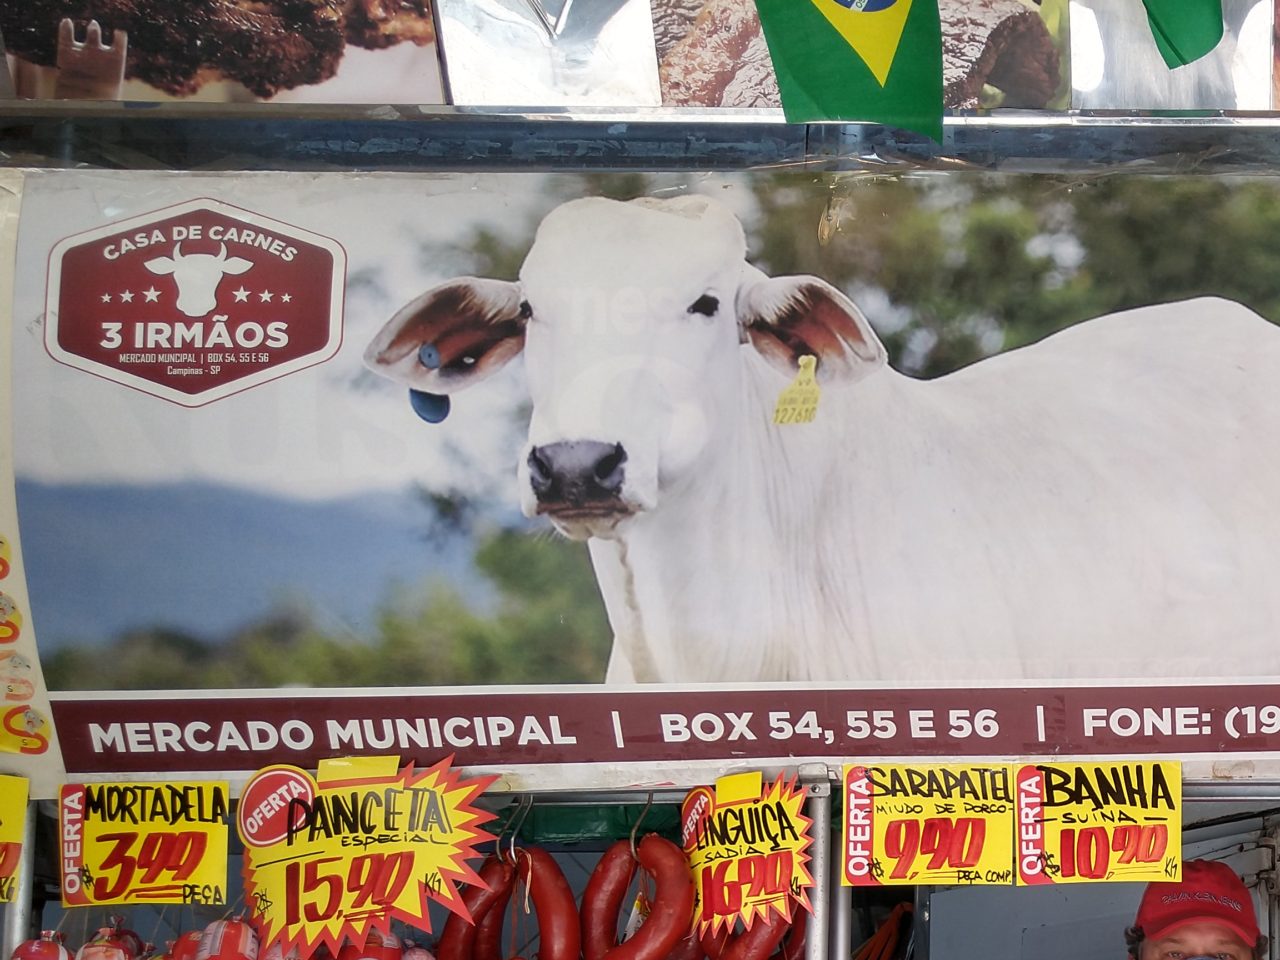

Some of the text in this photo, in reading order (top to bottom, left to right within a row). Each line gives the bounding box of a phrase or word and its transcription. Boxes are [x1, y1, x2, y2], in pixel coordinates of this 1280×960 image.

[103, 225, 298, 262] CASA DE CARNES
[100, 314, 289, 349] 3 IRMÃOS
[119, 353, 157, 364] MERCADO
[207, 353, 224, 364] BOX
[167, 365, 221, 377] Campinas SP
[88, 717, 316, 753] MERCADO
[326, 714, 578, 750] MUNICIPAL
[661, 711, 755, 743] BOX
[769, 708, 834, 744] 54,
[846, 709, 897, 739] 55
[911, 709, 934, 739] E
[947, 708, 999, 738] 56
[1084, 706, 1211, 738] FONE:
[865, 766, 1014, 803] SARAPATEL
[1036, 764, 1175, 811] BANHA
[84, 785, 228, 825] MORTADELA
[246, 780, 307, 836] OFERTA
[286, 787, 452, 846] PANCETA
[936, 803, 956, 814] DE
[964, 803, 1006, 813] PORCO
[64, 791, 84, 895] OFERTA
[341, 831, 449, 848] ESPECIAL
[695, 798, 799, 852] LINGUIÇA
[848, 776, 871, 876] OFERTA
[1020, 776, 1042, 875] OFERTA
[703, 845, 765, 864] SADIA
[884, 818, 986, 880] 9,90
[182, 884, 223, 905] PEÇA
[958, 870, 982, 885] PEÇA
